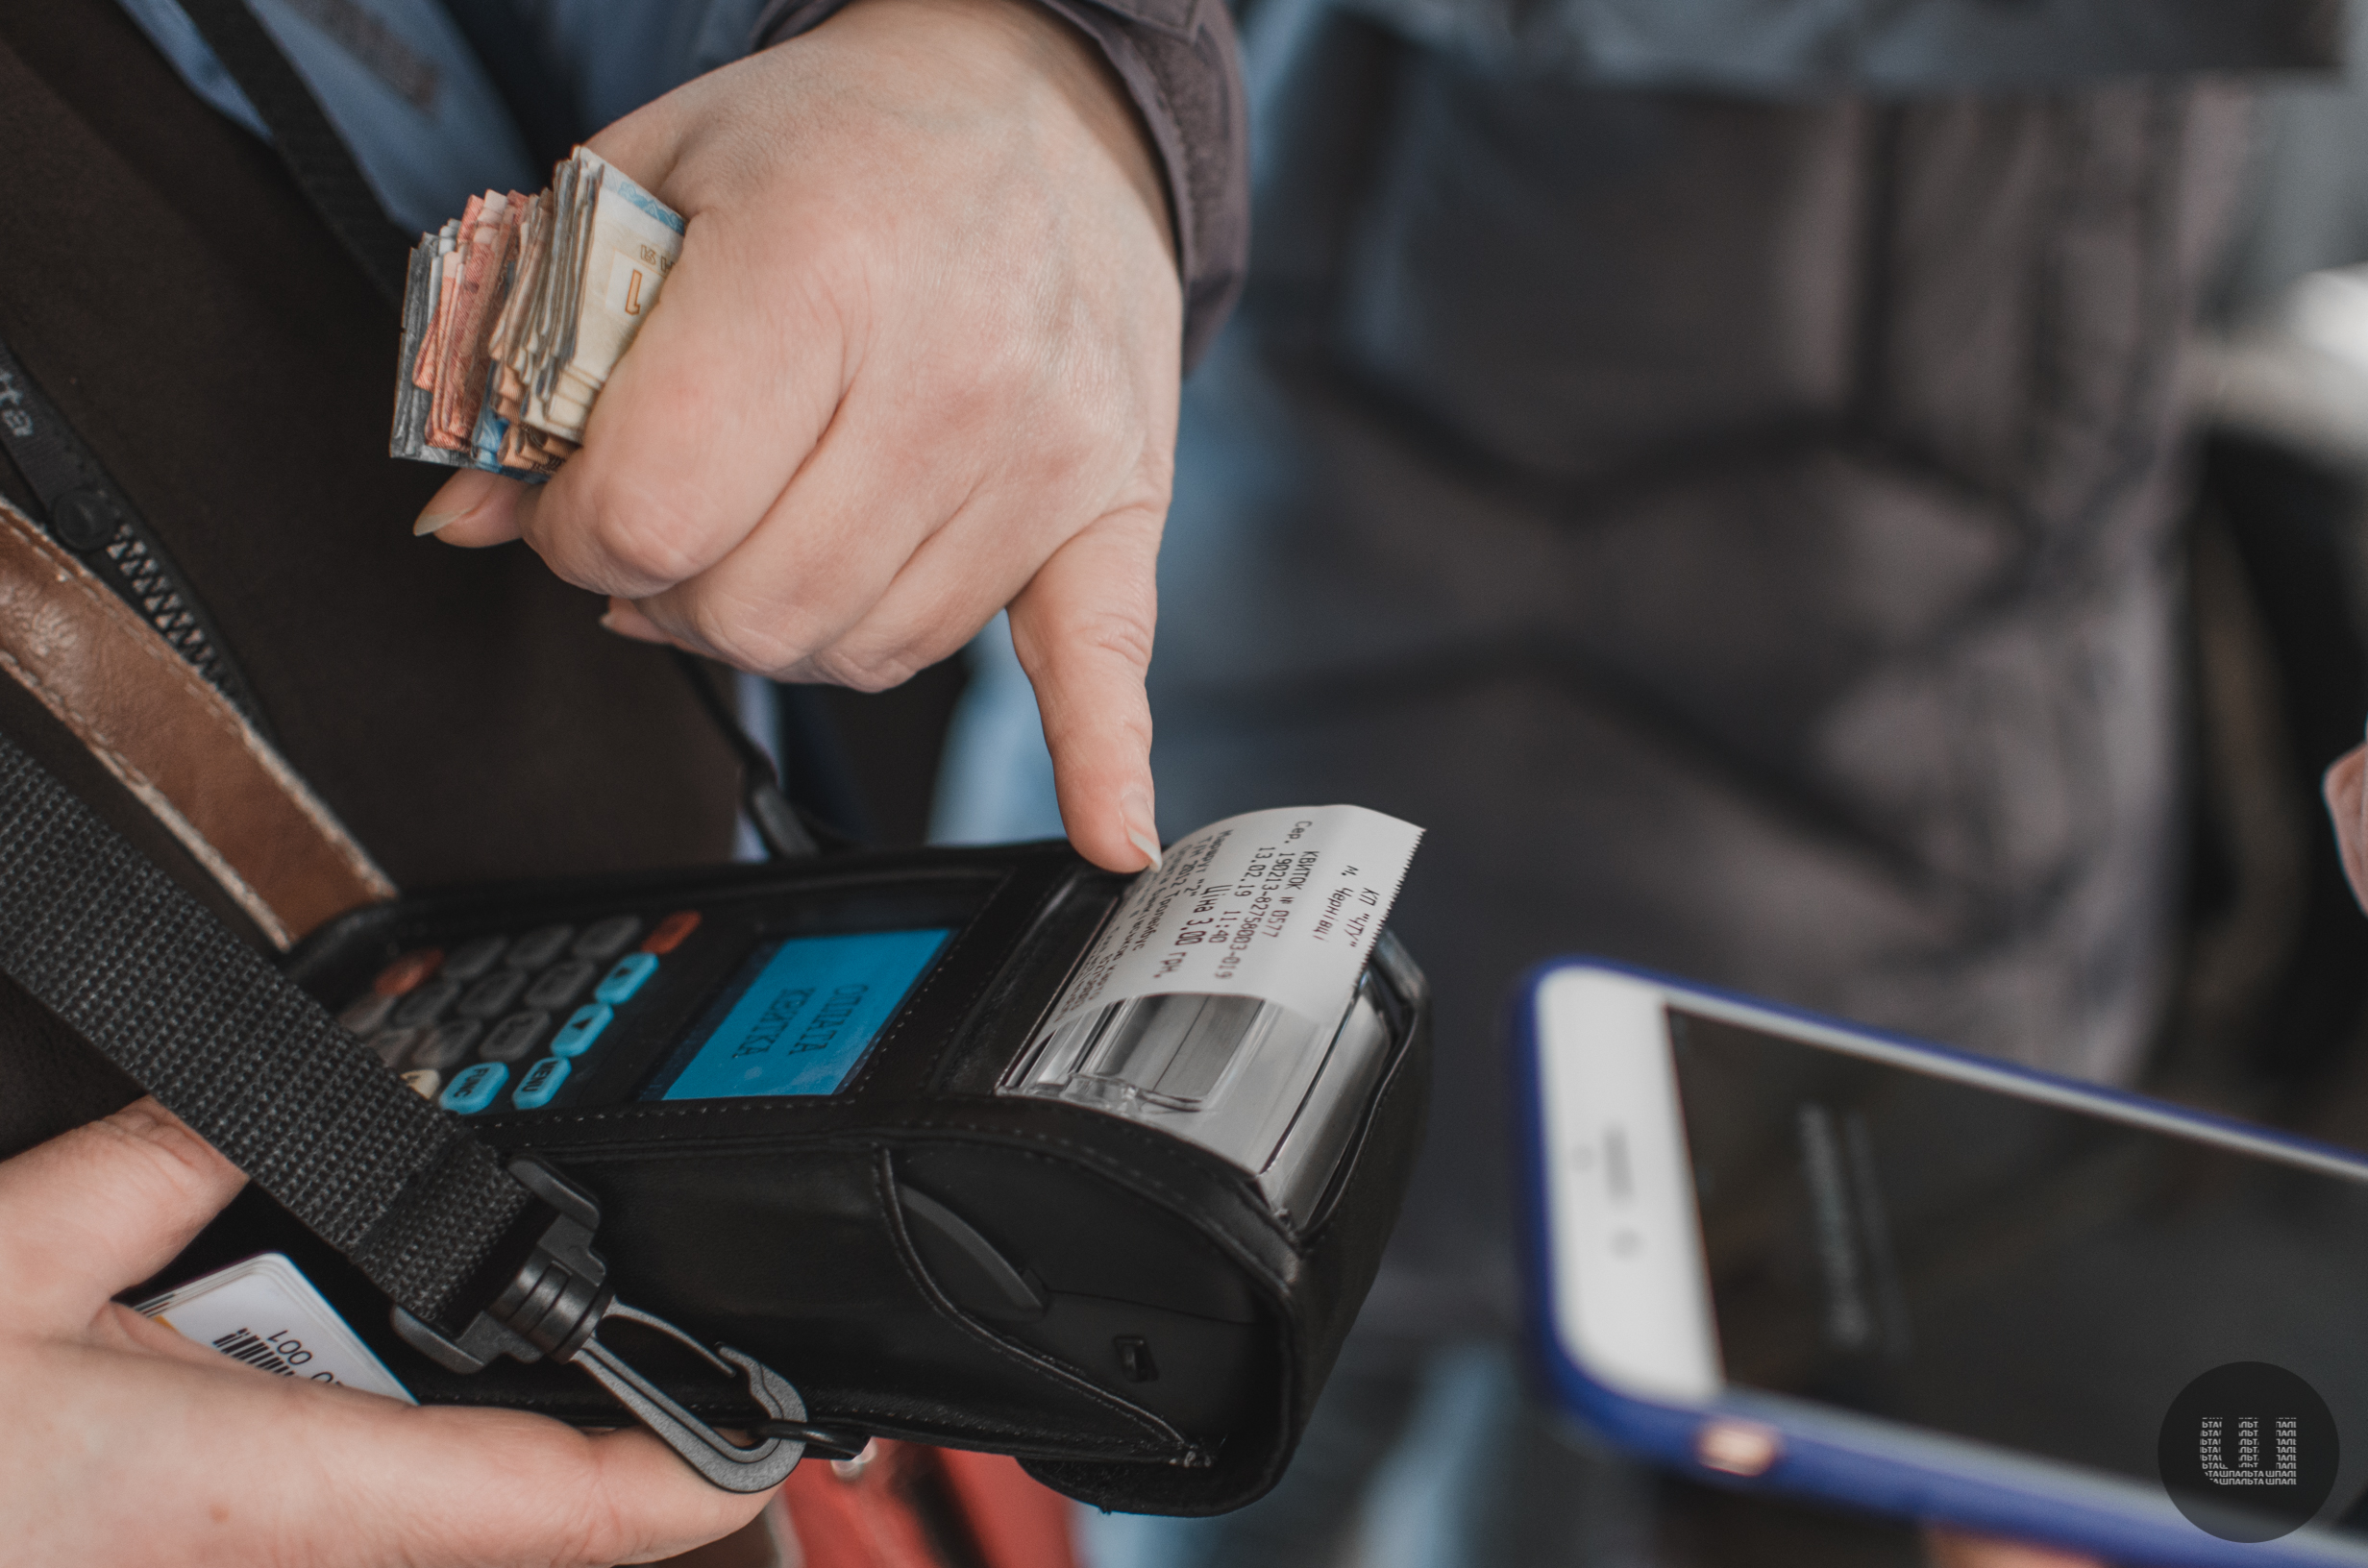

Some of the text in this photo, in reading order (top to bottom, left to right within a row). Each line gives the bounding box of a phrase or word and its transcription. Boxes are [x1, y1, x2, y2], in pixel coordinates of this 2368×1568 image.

[625, 269, 642, 315] 1
[1196, 829, 1234, 873] Маршрут
[1284, 821, 1313, 844] Сер.
[1170, 859, 1197, 889] 2012
[1283, 850, 1320, 891] КВИТОК
[1208, 846, 1276, 943] 13.02.19 11:40
[1312, 865, 1359, 942] м. Чернівці
[1132, 890, 1181, 952] Тролейбус
[1153, 884, 1233, 979] Ціна 3.00 грн.
[1261, 910, 1290, 938] 0577
[1344, 887, 1380, 947] КП "ЧТУ"
[788, 984, 869, 1056] ОПЛАТА
[454, 1067, 491, 1097] FUNC
[522, 1061, 558, 1092] MENU
[267, 1330, 312, 1365] 001
